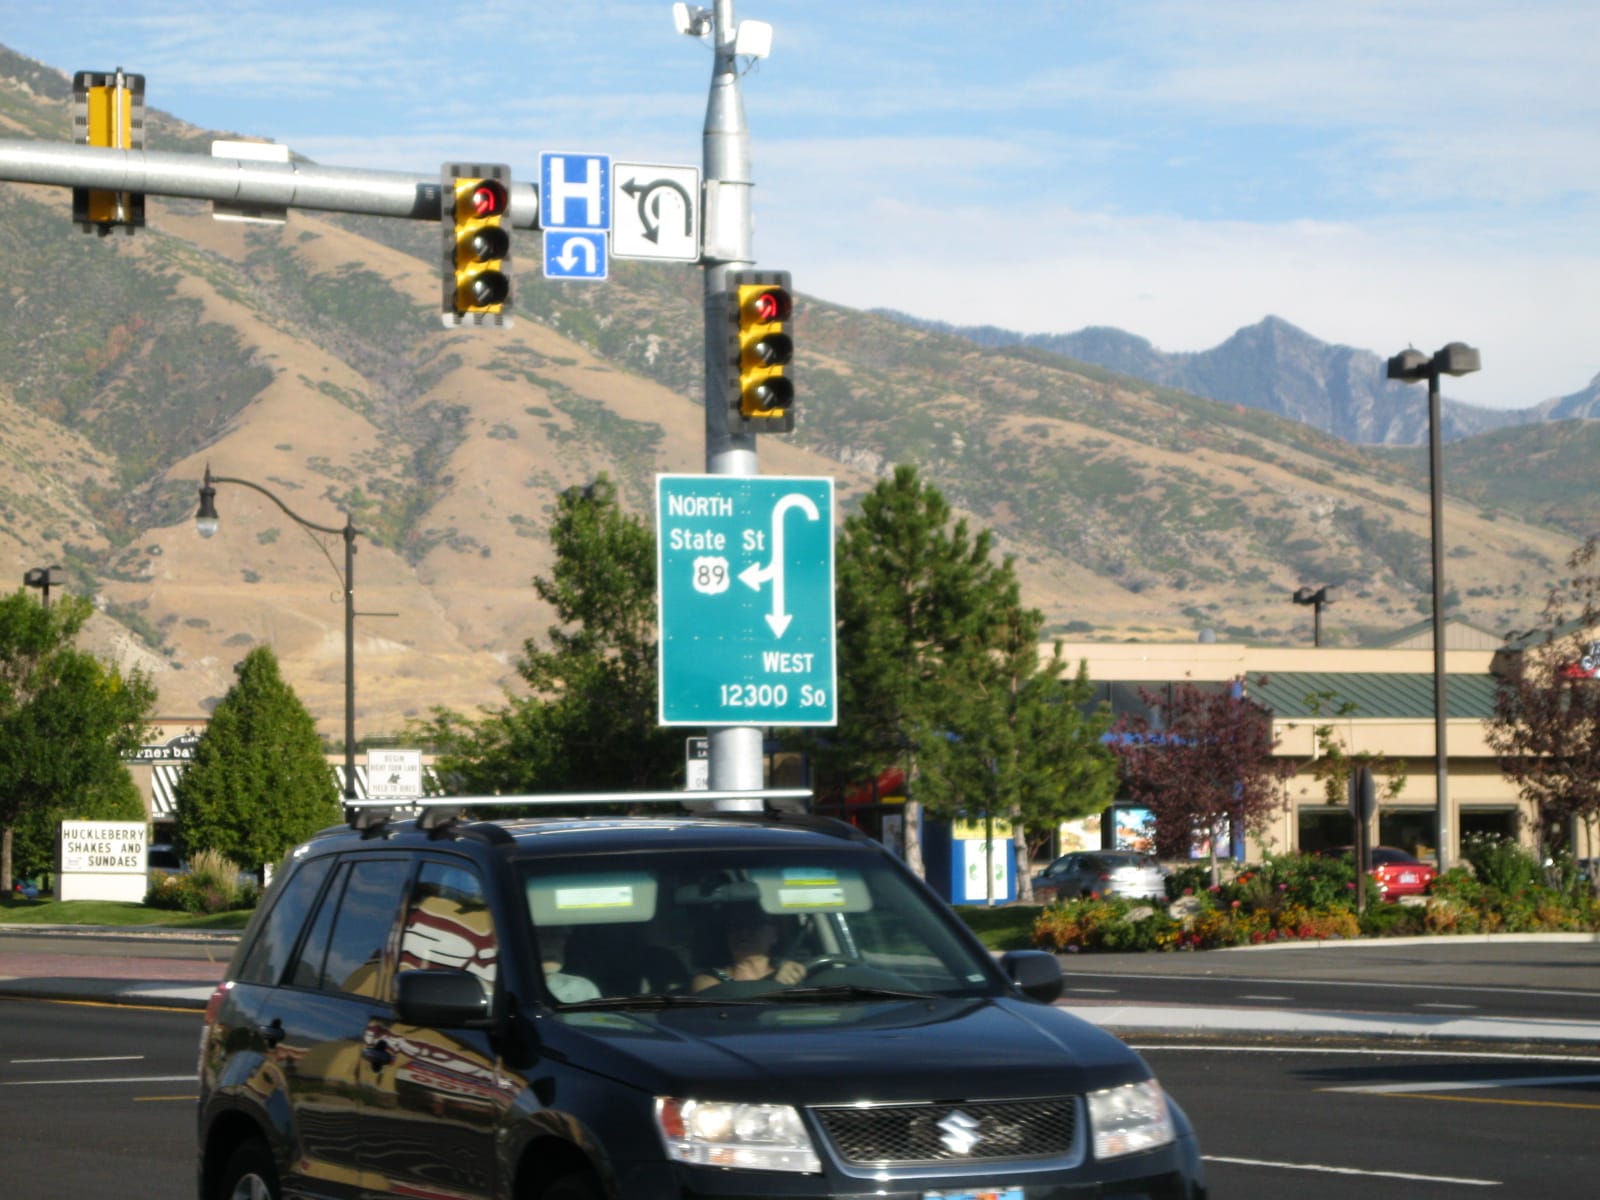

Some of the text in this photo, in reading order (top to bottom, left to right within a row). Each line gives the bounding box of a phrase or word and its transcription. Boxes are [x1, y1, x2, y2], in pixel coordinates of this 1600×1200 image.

[550, 157, 601, 226] H
[668, 495, 733, 517] NORTH
[669, 528, 765, 551] State St
[697, 565, 725, 587] 89
[762, 651, 814, 673] WEST
[720, 684, 827, 707] 12300 So
[63, 828, 145, 841] HUCKLEBERRY
[67, 842, 142, 854] SHAKES AND
[88, 856, 138, 867] SUNDAES
